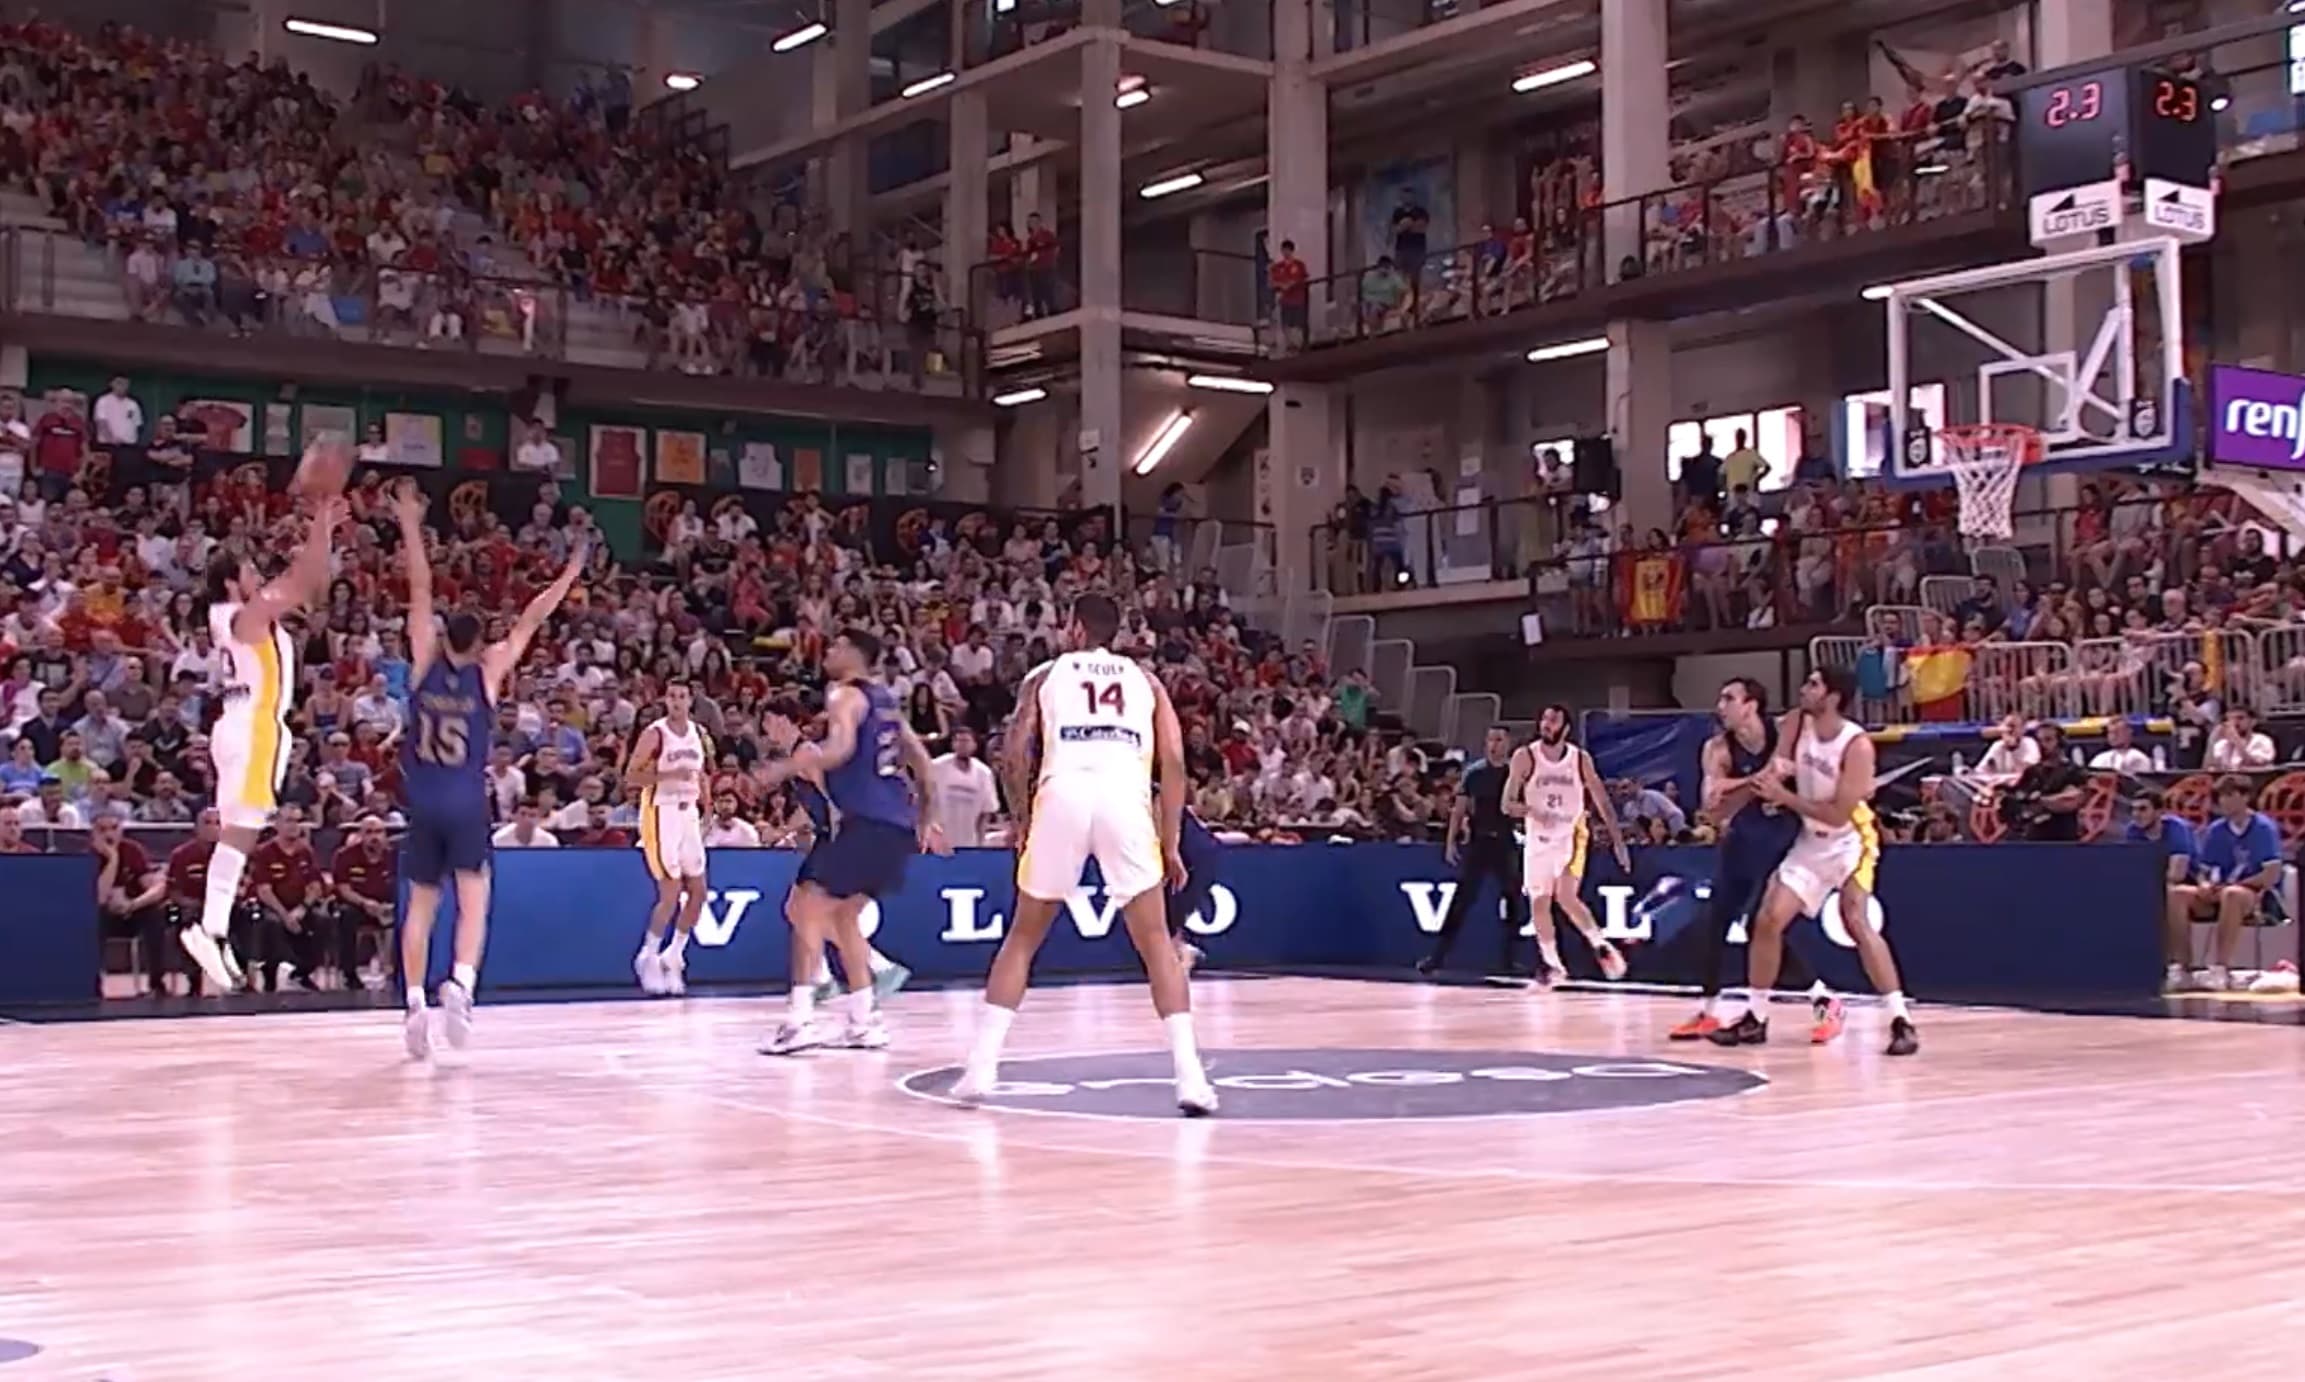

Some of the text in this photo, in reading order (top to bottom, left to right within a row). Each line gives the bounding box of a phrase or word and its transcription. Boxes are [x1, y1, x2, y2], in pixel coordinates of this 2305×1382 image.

[2047, 82, 2102, 127] 2.3
[2156, 81, 2198, 122] 2.3
[2043, 206, 2111, 234] LOTUS
[2155, 204, 2206, 231] LOTUS
[1080, 681, 1126, 716] 14
[415, 711, 469, 767] 15
[1546, 793, 1563, 809] 21
[679, 885, 1238, 946] VLVO
[1401, 881, 1885, 947] VLO
